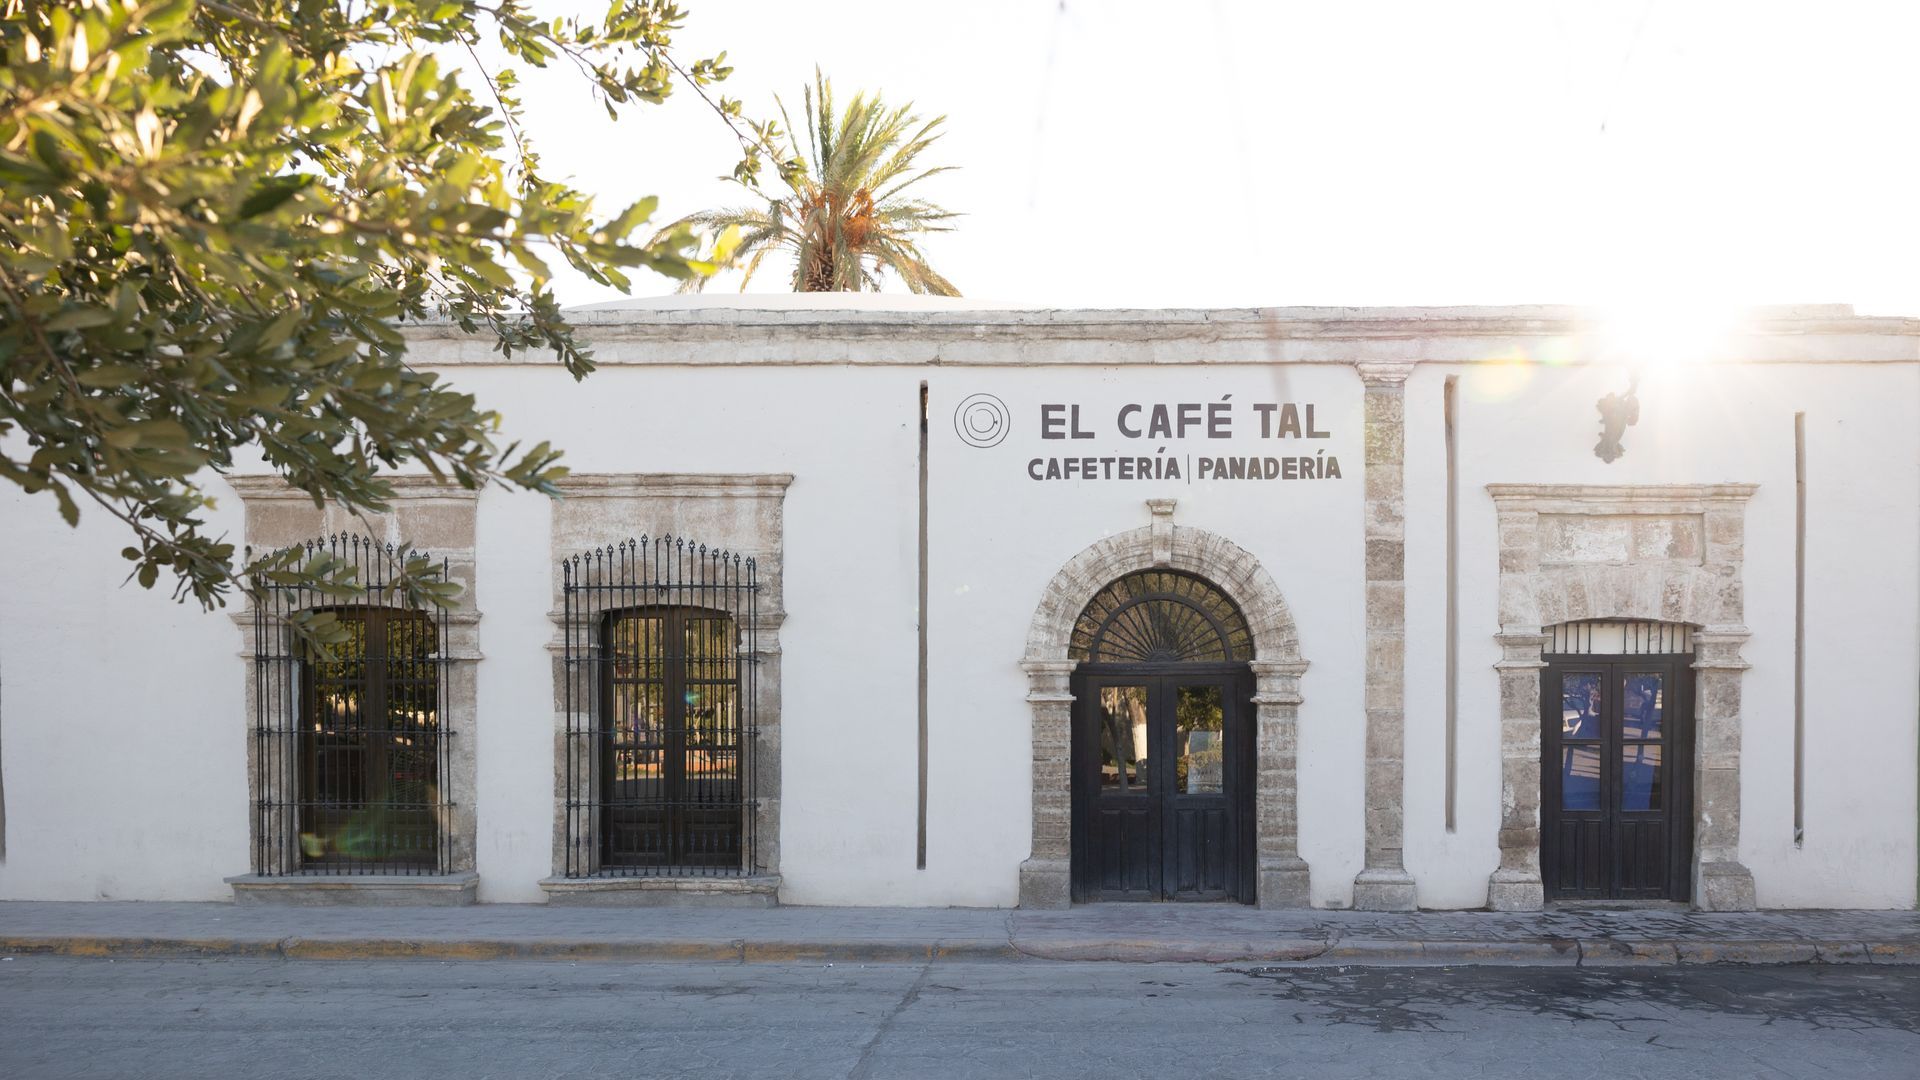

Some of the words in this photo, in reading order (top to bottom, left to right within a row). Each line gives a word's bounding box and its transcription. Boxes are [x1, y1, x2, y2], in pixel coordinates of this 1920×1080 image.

[1040, 403, 1096, 440] EL
[1117, 393, 1233, 439] CAFÉ
[1253, 403, 1331, 440] TAL
[1027, 446, 1182, 481] CAFETERÍA
[1197, 448, 1343, 480] PANADERÍA
